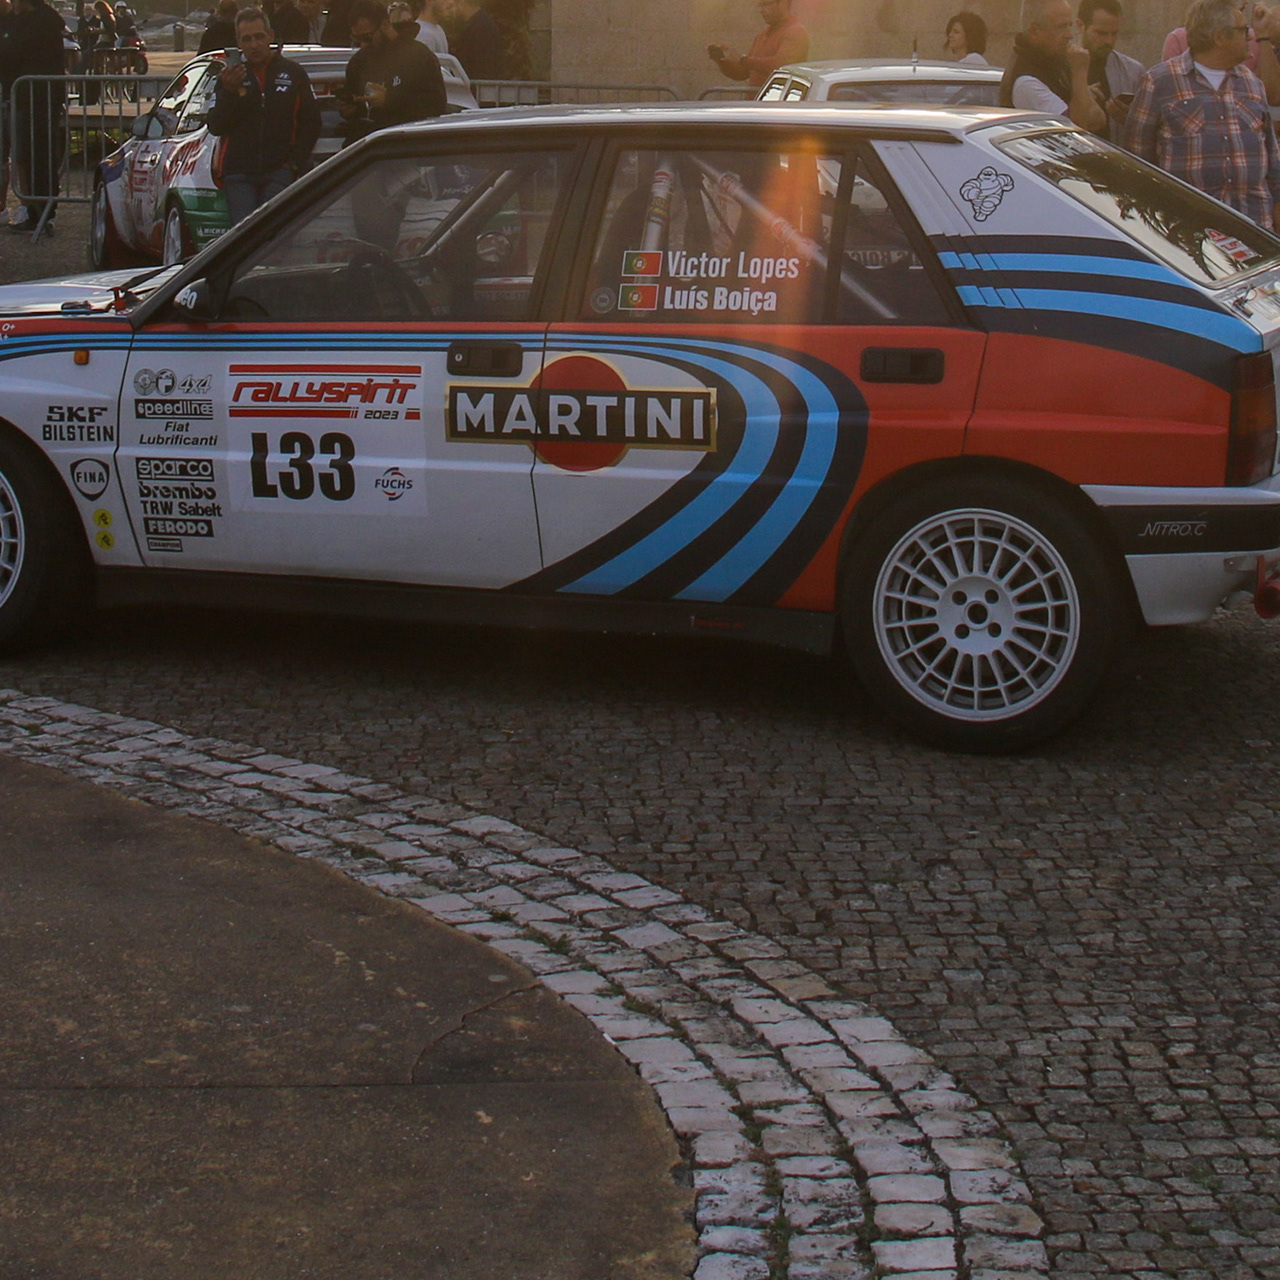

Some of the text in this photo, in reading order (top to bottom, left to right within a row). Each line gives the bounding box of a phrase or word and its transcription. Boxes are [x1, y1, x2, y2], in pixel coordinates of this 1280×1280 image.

[667, 250, 800, 283] Victor Lopes
[663, 286, 778, 317] Luís Boiça
[178, 374, 213, 394] 4x4
[47, 406, 108, 422] SKF
[137, 401, 213, 417] speedline
[363, 410, 399, 420] 2023
[456, 391, 705, 439] MARTINI
[42, 424, 115, 441] BILSTEIN
[164, 421, 190, 432] Fiat
[139, 434, 218, 446] Lubrificanti
[137, 459, 213, 478] sparco
[250, 431, 356, 501] L33
[76, 471, 106, 483] FINA
[374, 478, 413, 489] FUCHS
[138, 481, 217, 499] brembo
[140, 500, 223, 517] TRW Sabelt
[149, 522, 208, 534] FERODO
